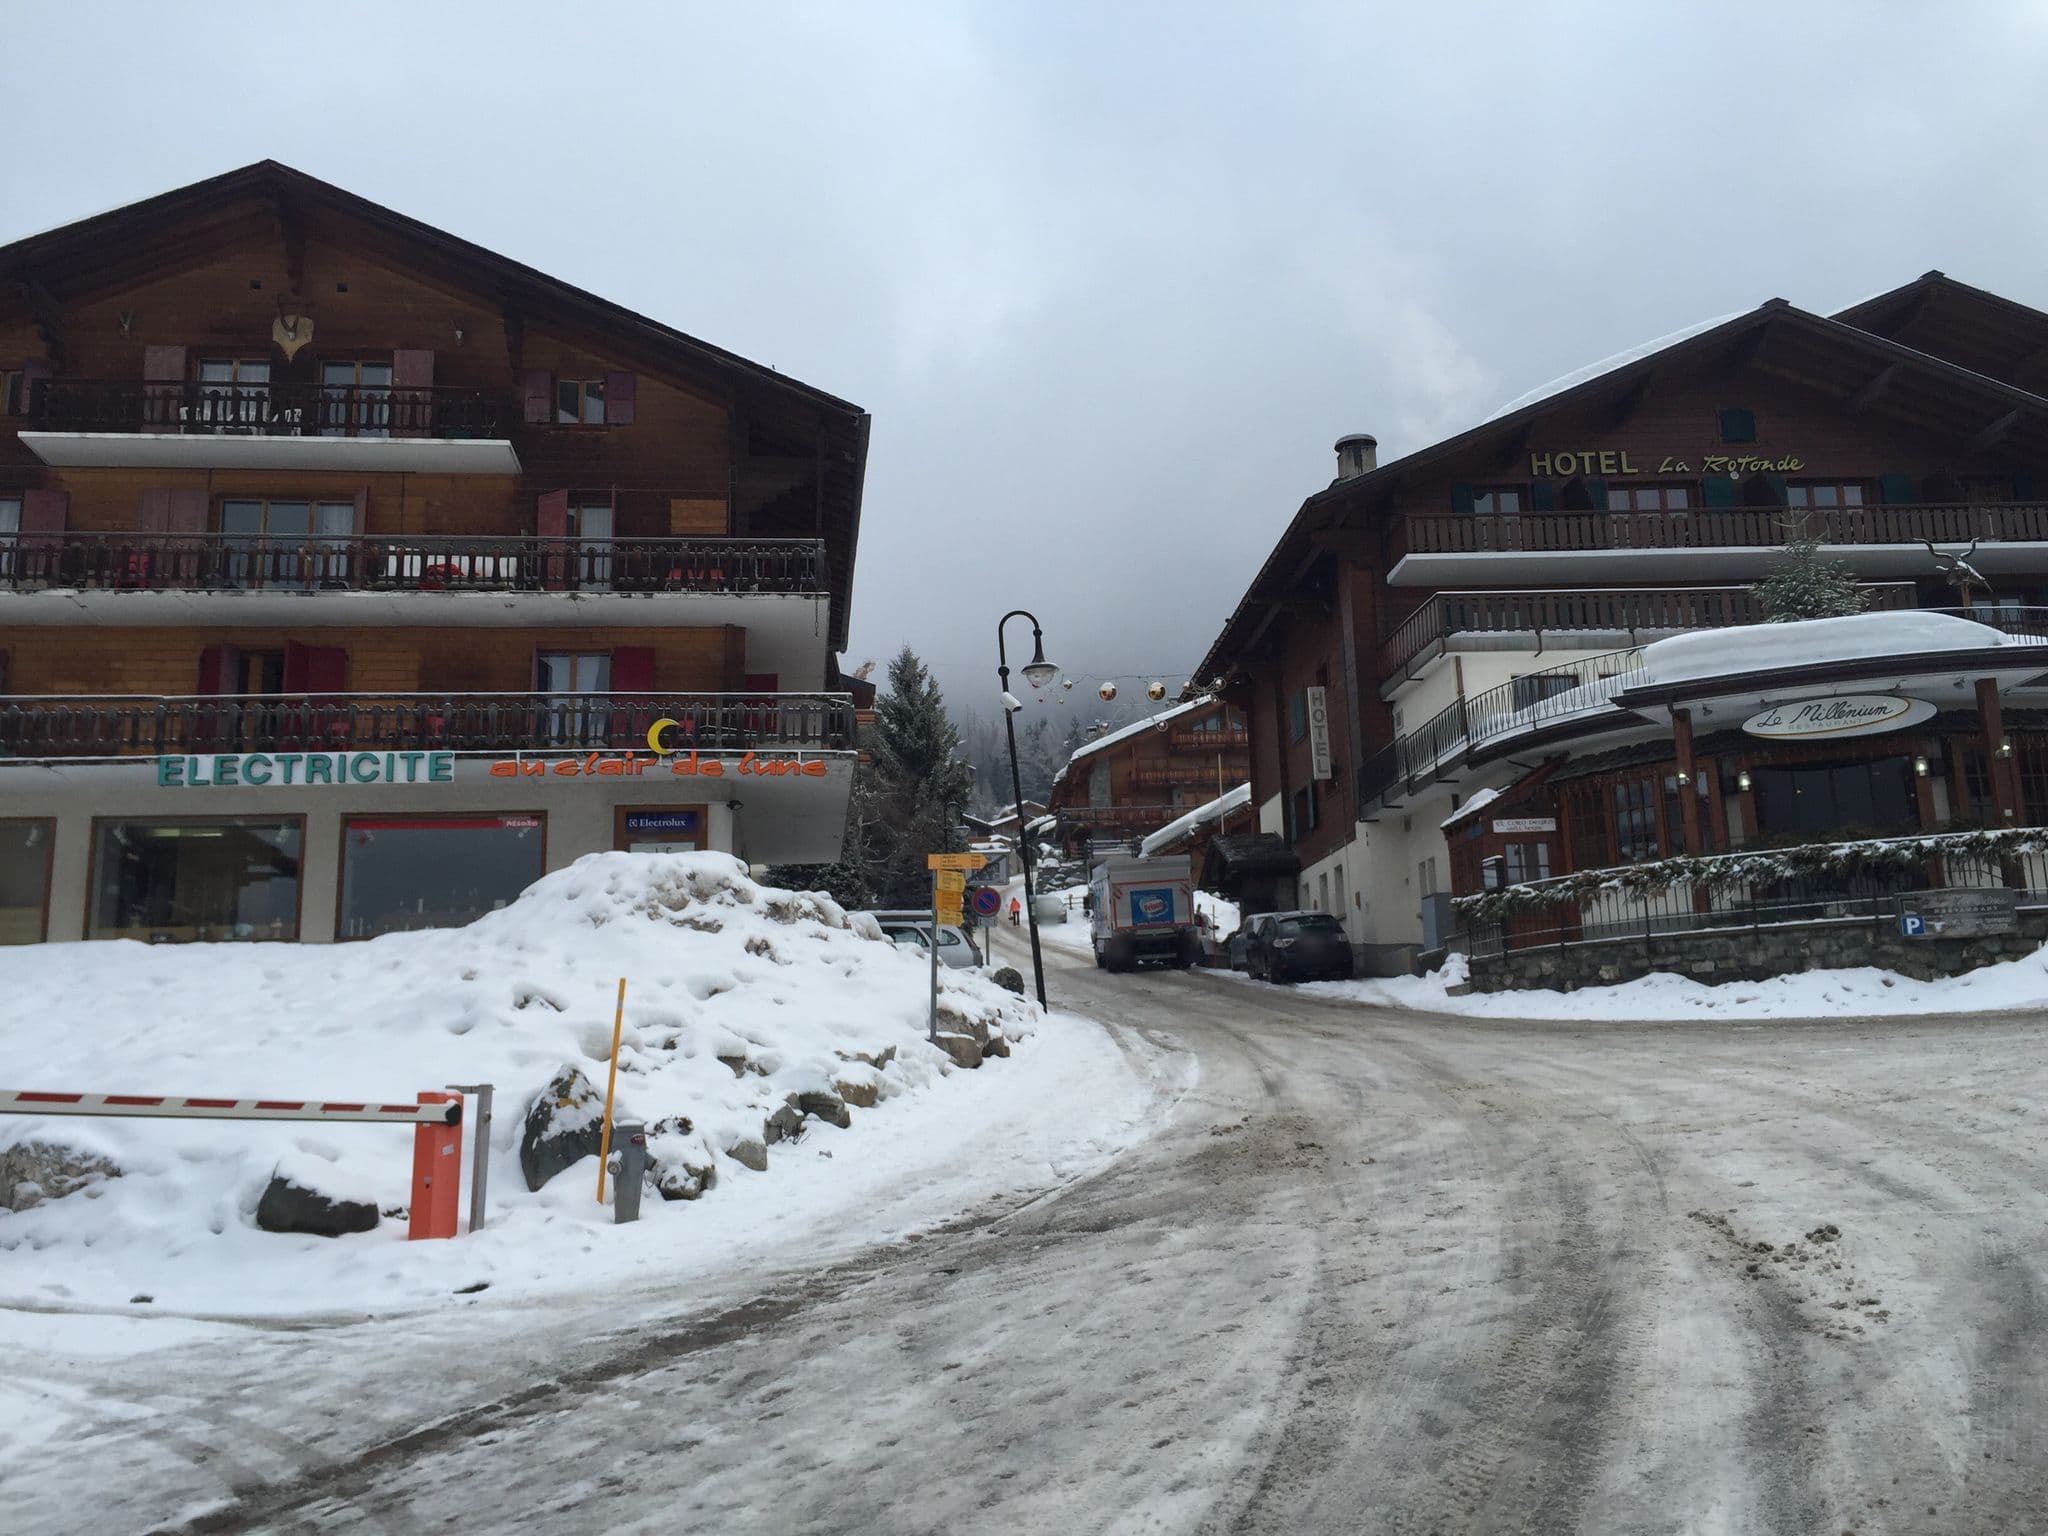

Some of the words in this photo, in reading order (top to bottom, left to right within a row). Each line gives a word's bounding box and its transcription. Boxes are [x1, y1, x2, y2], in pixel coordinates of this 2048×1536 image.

[1531, 451, 1638, 476] HOTEL
[1657, 456, 1690, 473] La
[1703, 454, 1806, 473] Rotonde
[1757, 708, 1783, 727] Le
[1790, 701, 1894, 724] Millénium
[1788, 718, 1863, 730] RESTAURANT
[1311, 691, 1329, 774] HOTEL
[157, 752, 454, 787] ELECTRICITE
[489, 759, 545, 777] au
[553, 751, 657, 777] clair
[671, 751, 724, 777] de
[738, 751, 829, 777] lune
[640, 818, 686, 828] Electrolux
[1906, 917, 1921, 935] P
